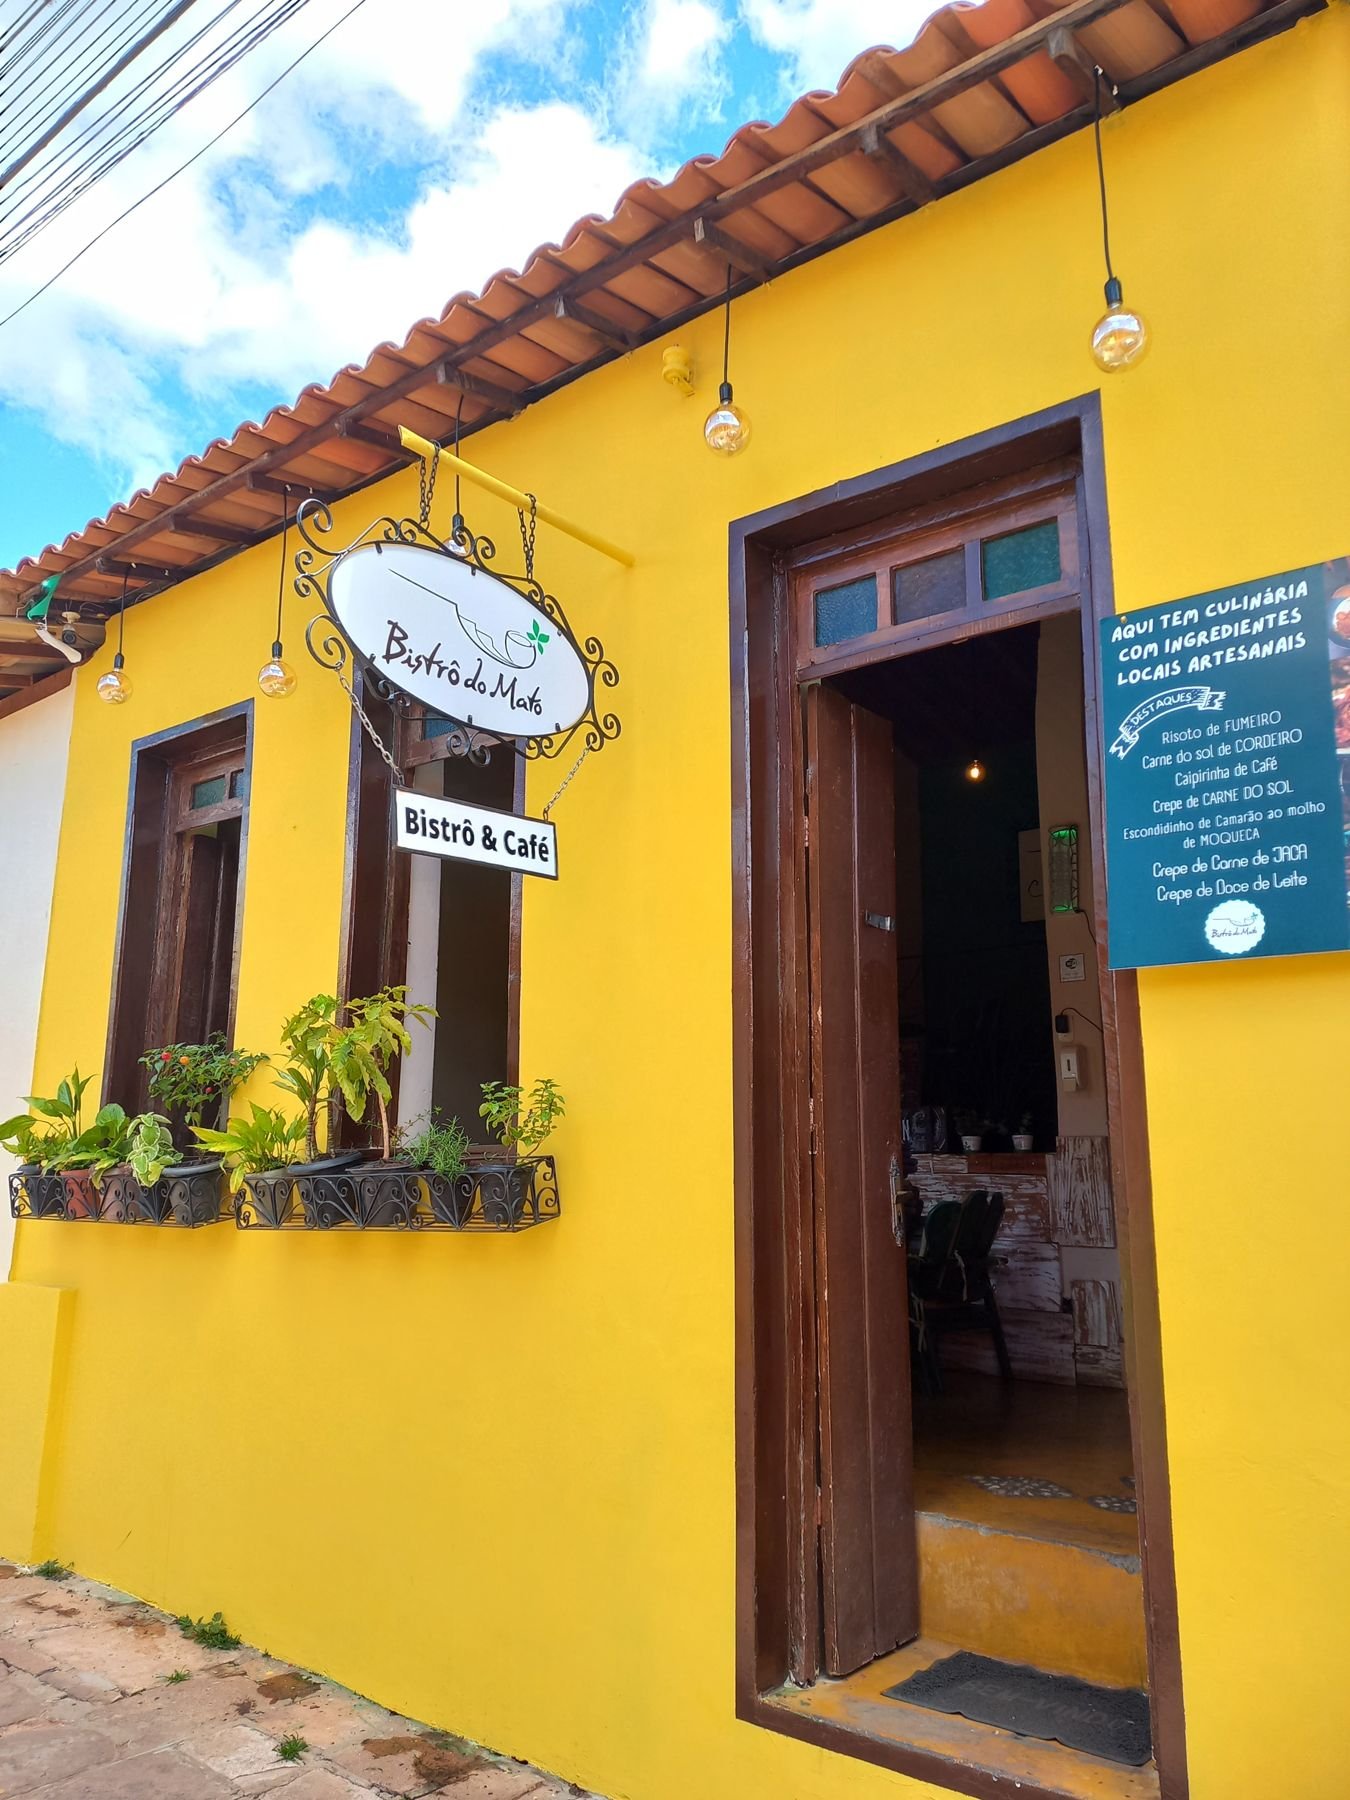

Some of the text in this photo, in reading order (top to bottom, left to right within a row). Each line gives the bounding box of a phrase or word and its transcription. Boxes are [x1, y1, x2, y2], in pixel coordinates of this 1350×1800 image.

[1111, 619, 1153, 642] AQUI
[1160, 609, 1198, 628] TEM
[1118, 608, 1302, 662] COM INGREDIENTES
[382, 619, 542, 715] Bistrô do Mato
[1117, 632, 1306, 685] LOCAIS ARTESANAIS
[1131, 693, 1192, 725] DESTAQUES
[1162, 711, 1281, 744] Risoto de FUMEIRO
[1142, 729, 1302, 769] Carne do sol de CORDEIRO
[1175, 767, 1229, 789] Caipirinha
[1234, 764, 1248, 776] de
[1153, 780, 1294, 815] Crepe de CARNE DO SOL
[405, 807, 549, 862] Bistrô & Café
[1124, 802, 1326, 839] Escondidinho de Camarão ao molho
[1183, 830, 1260, 849] de MOQUECA
[1153, 861, 1188, 881] Crepe
[1192, 857, 1208, 872] de
[1253, 849, 1269, 865] de
[1272, 843, 1307, 863] JACA
[1157, 871, 1307, 905] Crepe de Doce de Leite
